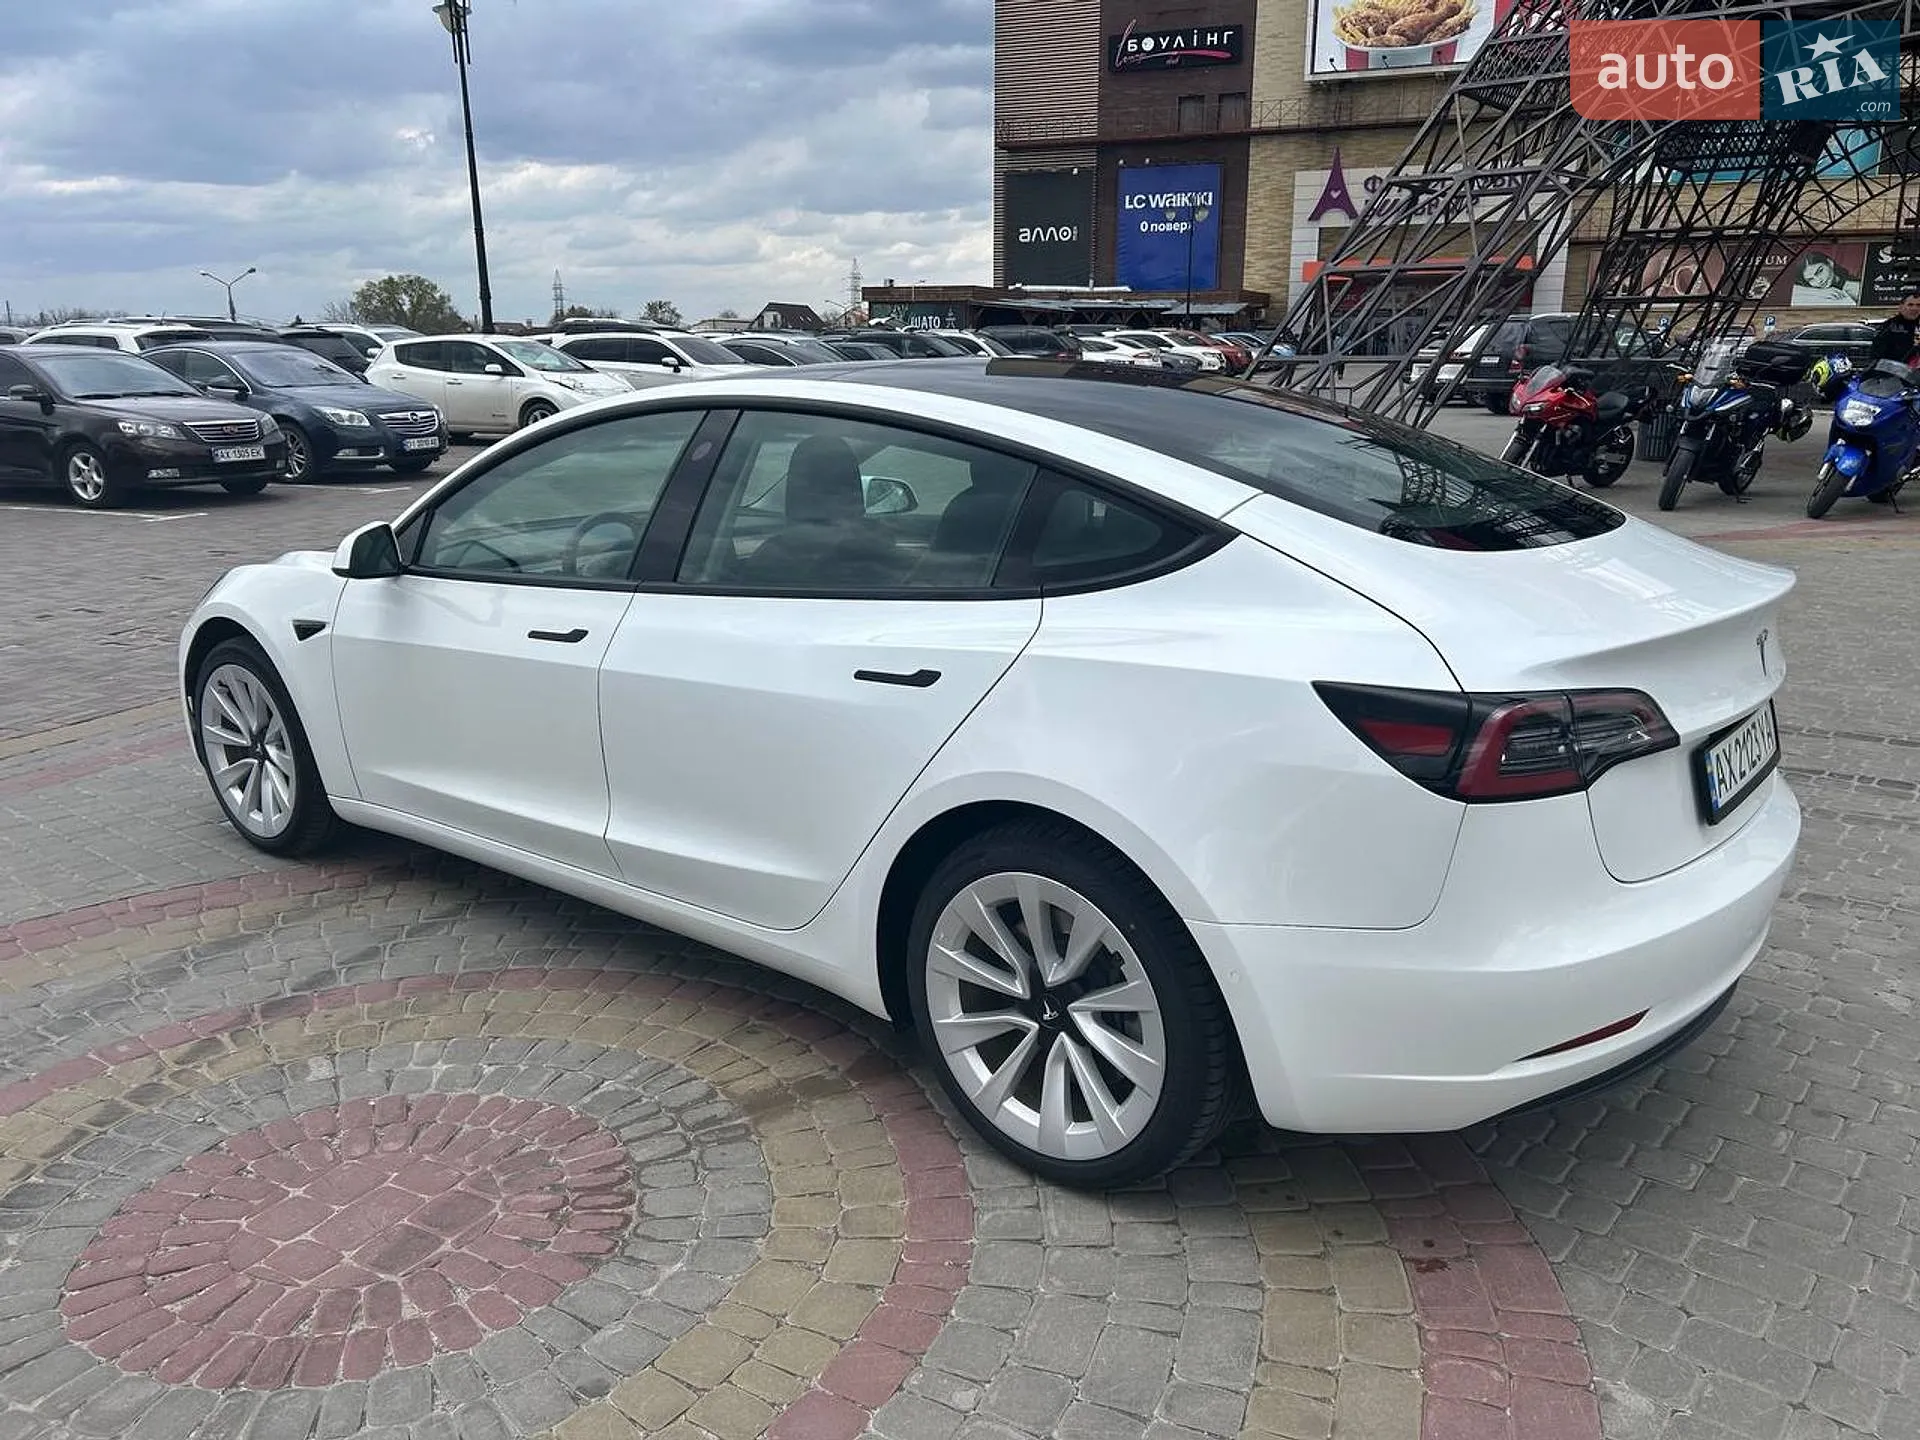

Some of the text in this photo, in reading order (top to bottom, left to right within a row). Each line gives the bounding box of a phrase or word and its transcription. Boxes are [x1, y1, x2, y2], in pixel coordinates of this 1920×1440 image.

[1124, 194, 1147, 209] LC
[1715, 742, 1739, 800] AX
[1734, 720, 1761, 781] 2123
